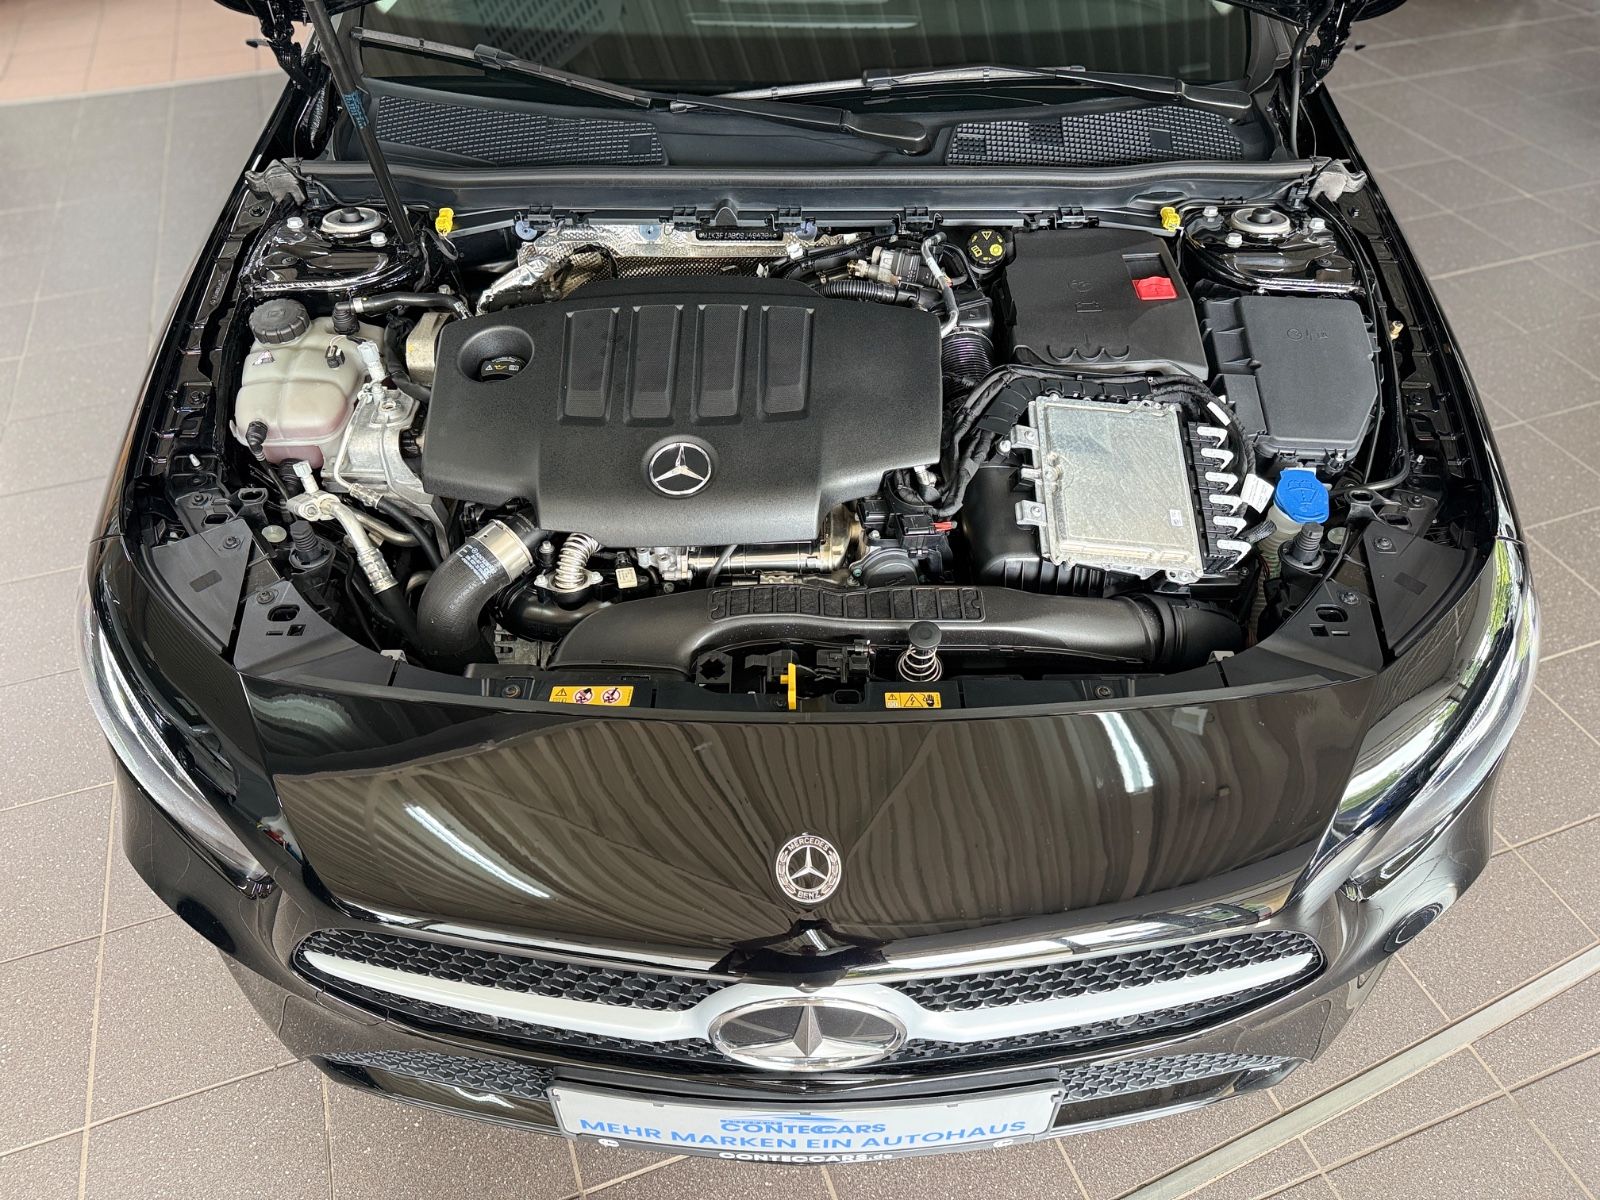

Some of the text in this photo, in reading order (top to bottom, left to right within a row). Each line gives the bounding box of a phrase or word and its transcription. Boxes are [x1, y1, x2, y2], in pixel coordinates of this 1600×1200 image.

[787, 837, 830, 852] MERCEDES
[797, 889, 821, 900] BENZ
[579, 1119, 1026, 1149] MEHR MARKEN EIN AUTOHAUS
